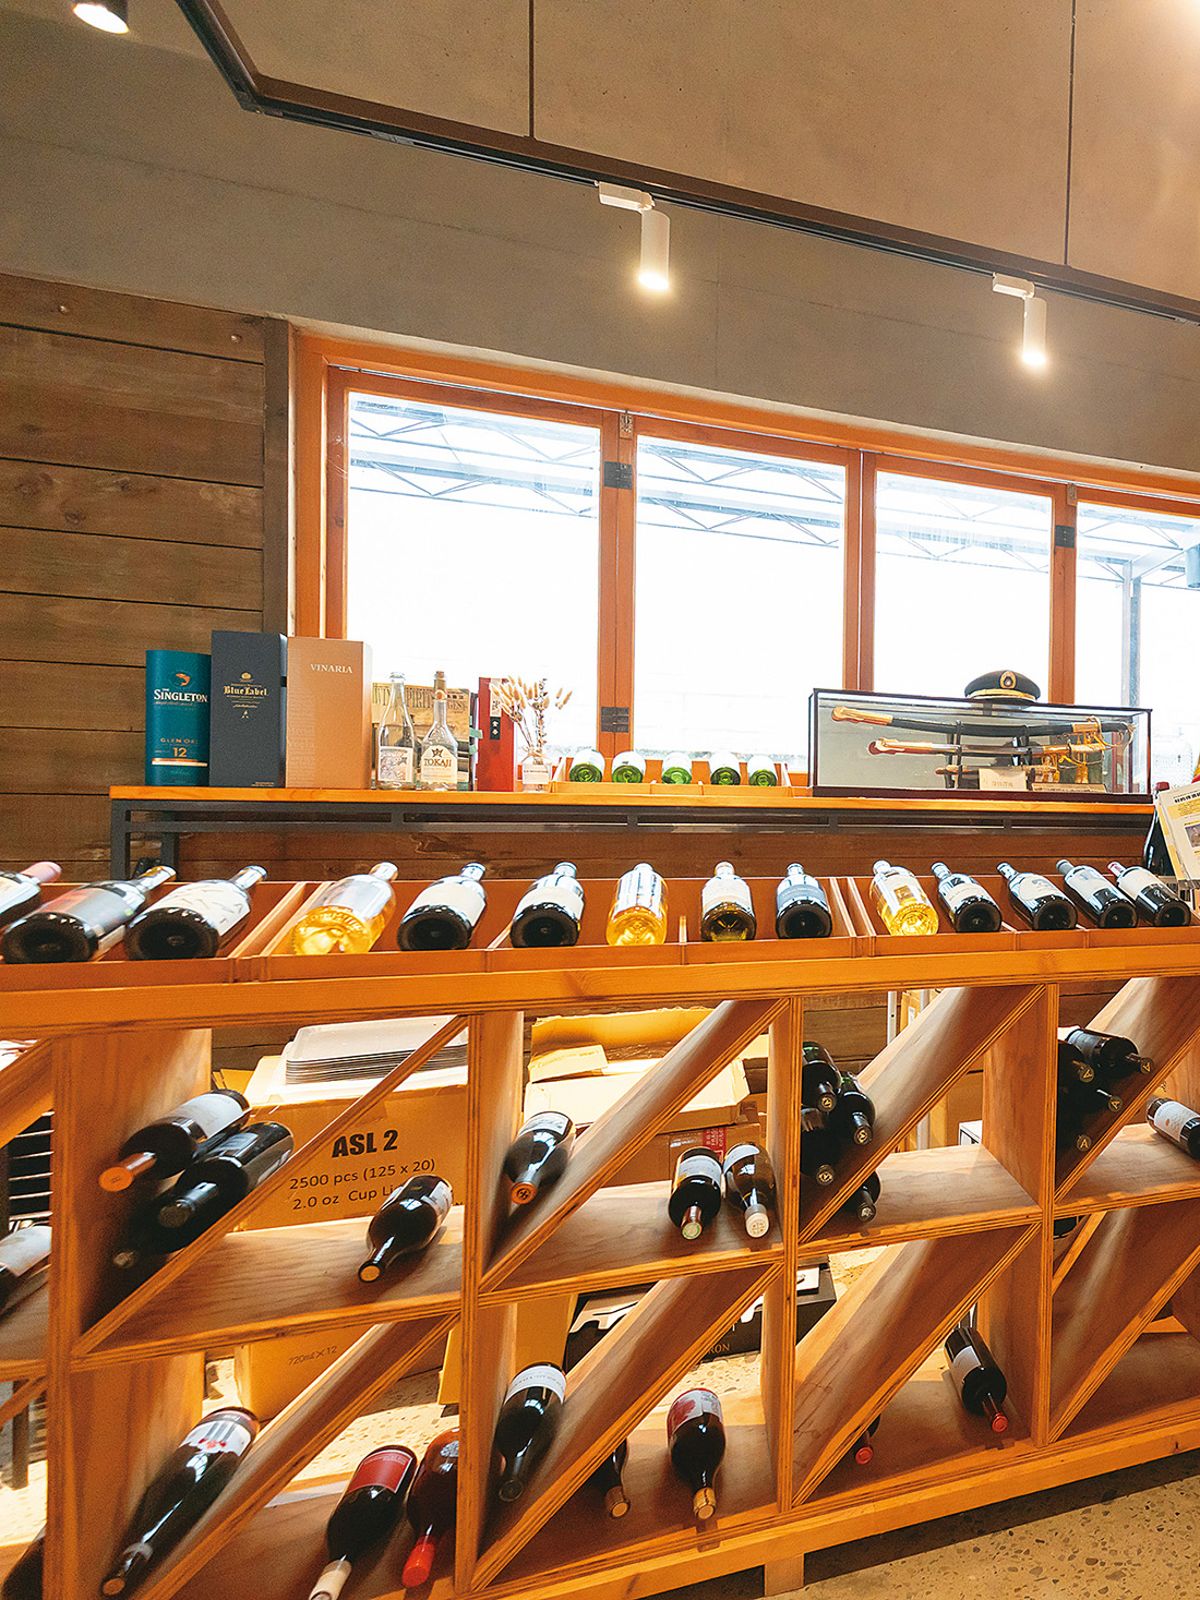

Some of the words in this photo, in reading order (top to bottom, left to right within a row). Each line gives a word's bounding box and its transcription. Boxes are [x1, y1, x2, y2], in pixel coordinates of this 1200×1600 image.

[310, 663, 353, 674] VINARIA
[153, 688, 208, 703] SINGLETON
[223, 686, 244, 695] Blue
[245, 687, 268, 696] Label
[173, 747, 187, 758] 12
[424, 758, 452, 768] TOKAJI
[331, 1132, 377, 1158] ASL
[383, 1129, 399, 1151] 2
[289, 1174, 329, 1190] 2500
[333, 1171, 359, 1187] pcs
[363, 1164, 396, 1182] (125
[399, 1165, 409, 1174] x
[412, 1158, 436, 1173] 20)
[292, 1196, 317, 1210] 2.0
[322, 1195, 340, 1206] oz
[348, 1189, 378, 1203] Cup
